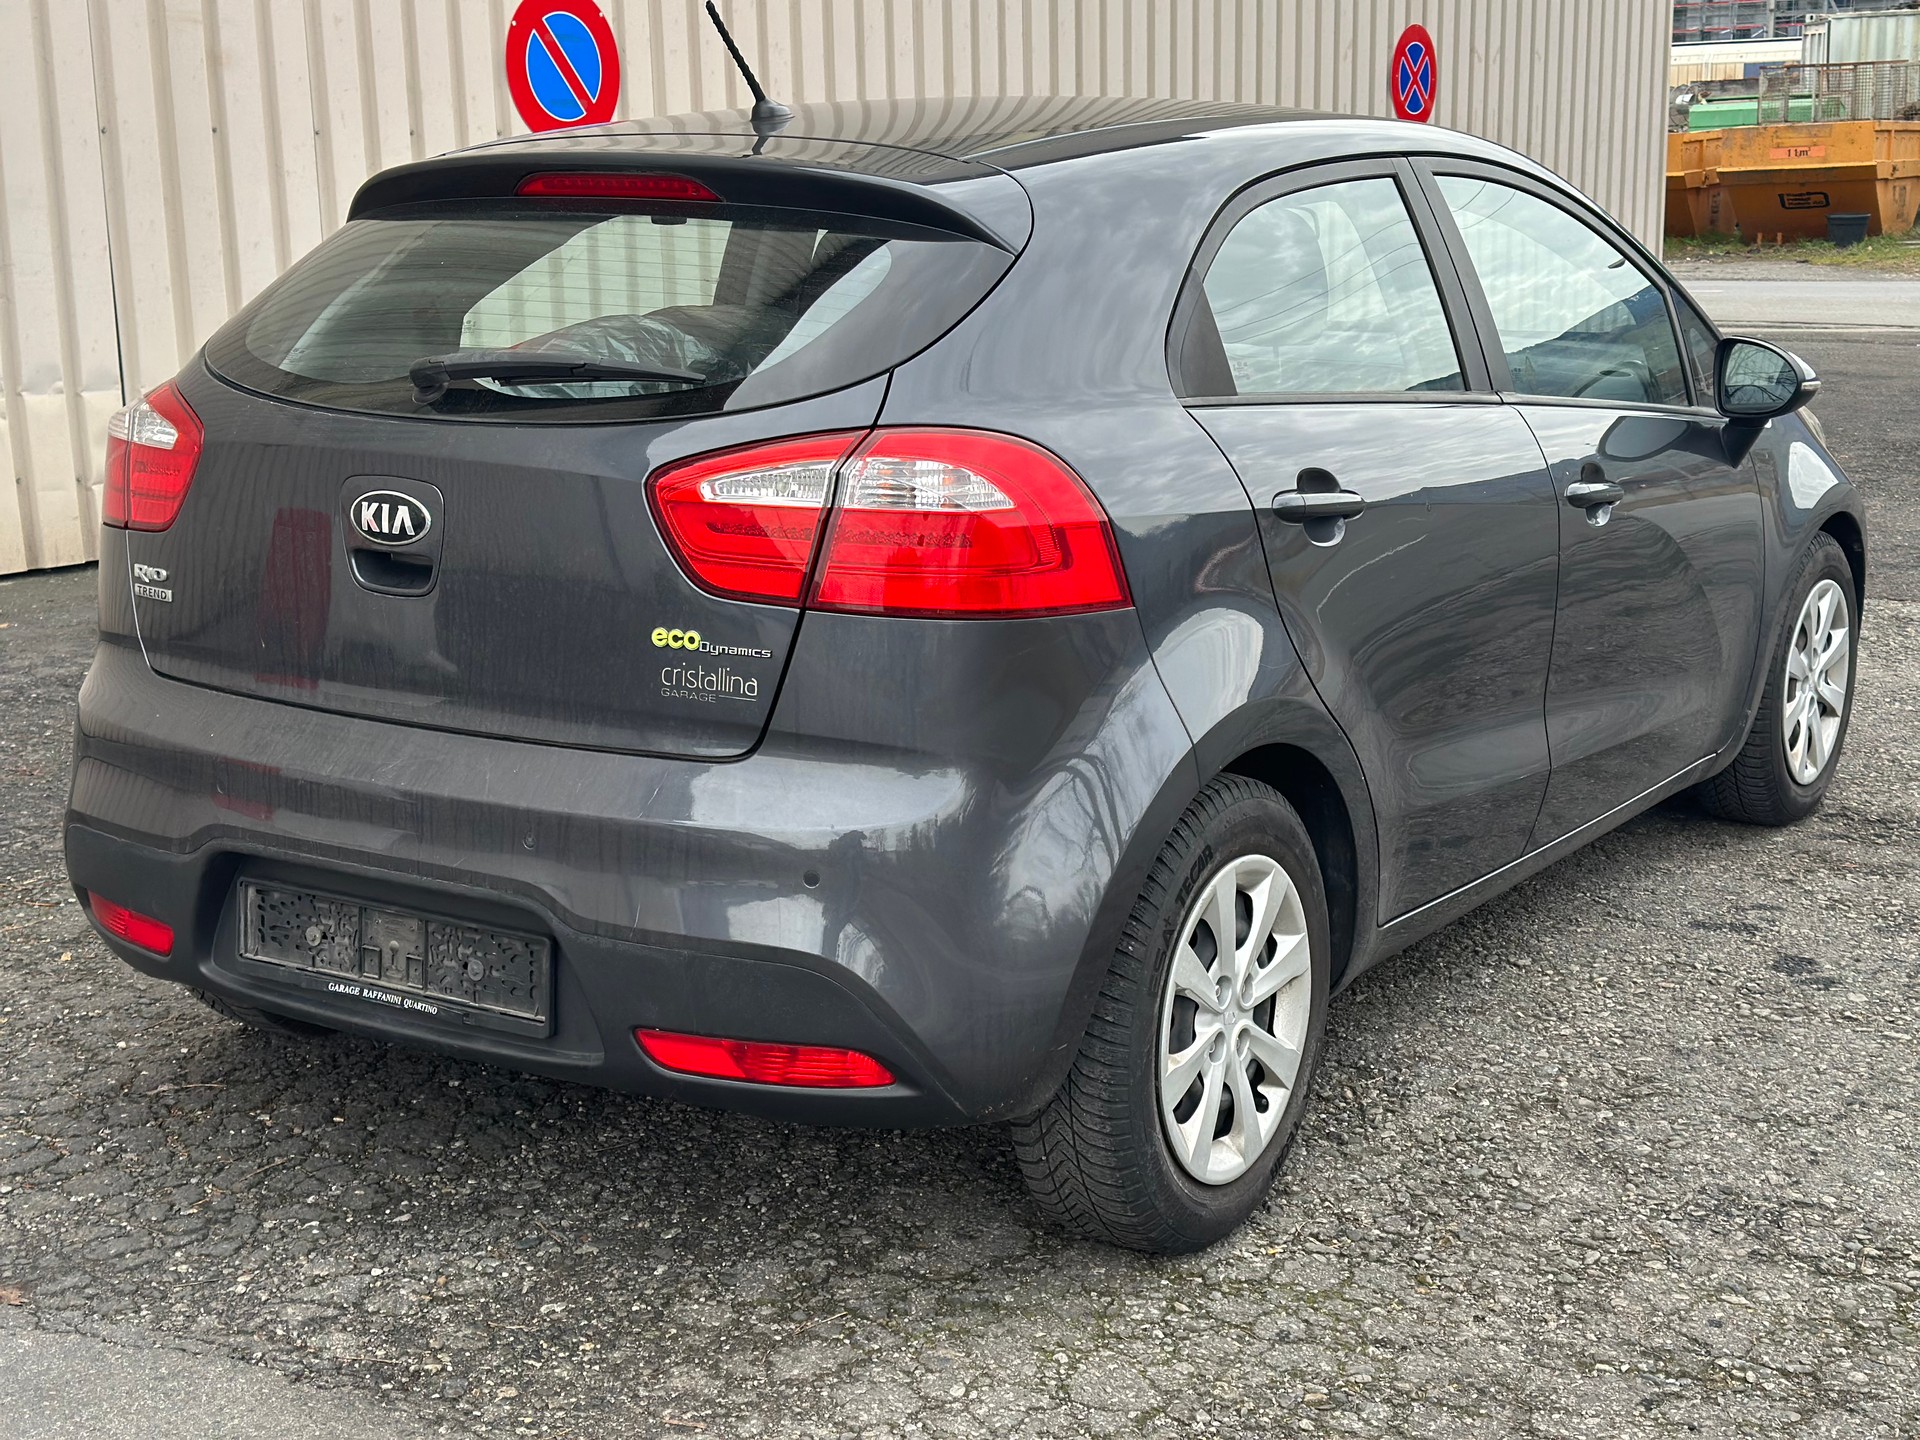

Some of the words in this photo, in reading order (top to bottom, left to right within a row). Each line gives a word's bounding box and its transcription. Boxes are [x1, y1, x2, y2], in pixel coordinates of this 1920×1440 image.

[361, 501, 416, 536] KIA
[137, 585, 167, 600] TREND
[661, 661, 758, 696] cristallina
[660, 687, 717, 704] GARAGE
[328, 982, 361, 996] GARAGE
[362, 988, 402, 1005] RAFFANINI
[403, 998, 438, 1015] QUARTINO
